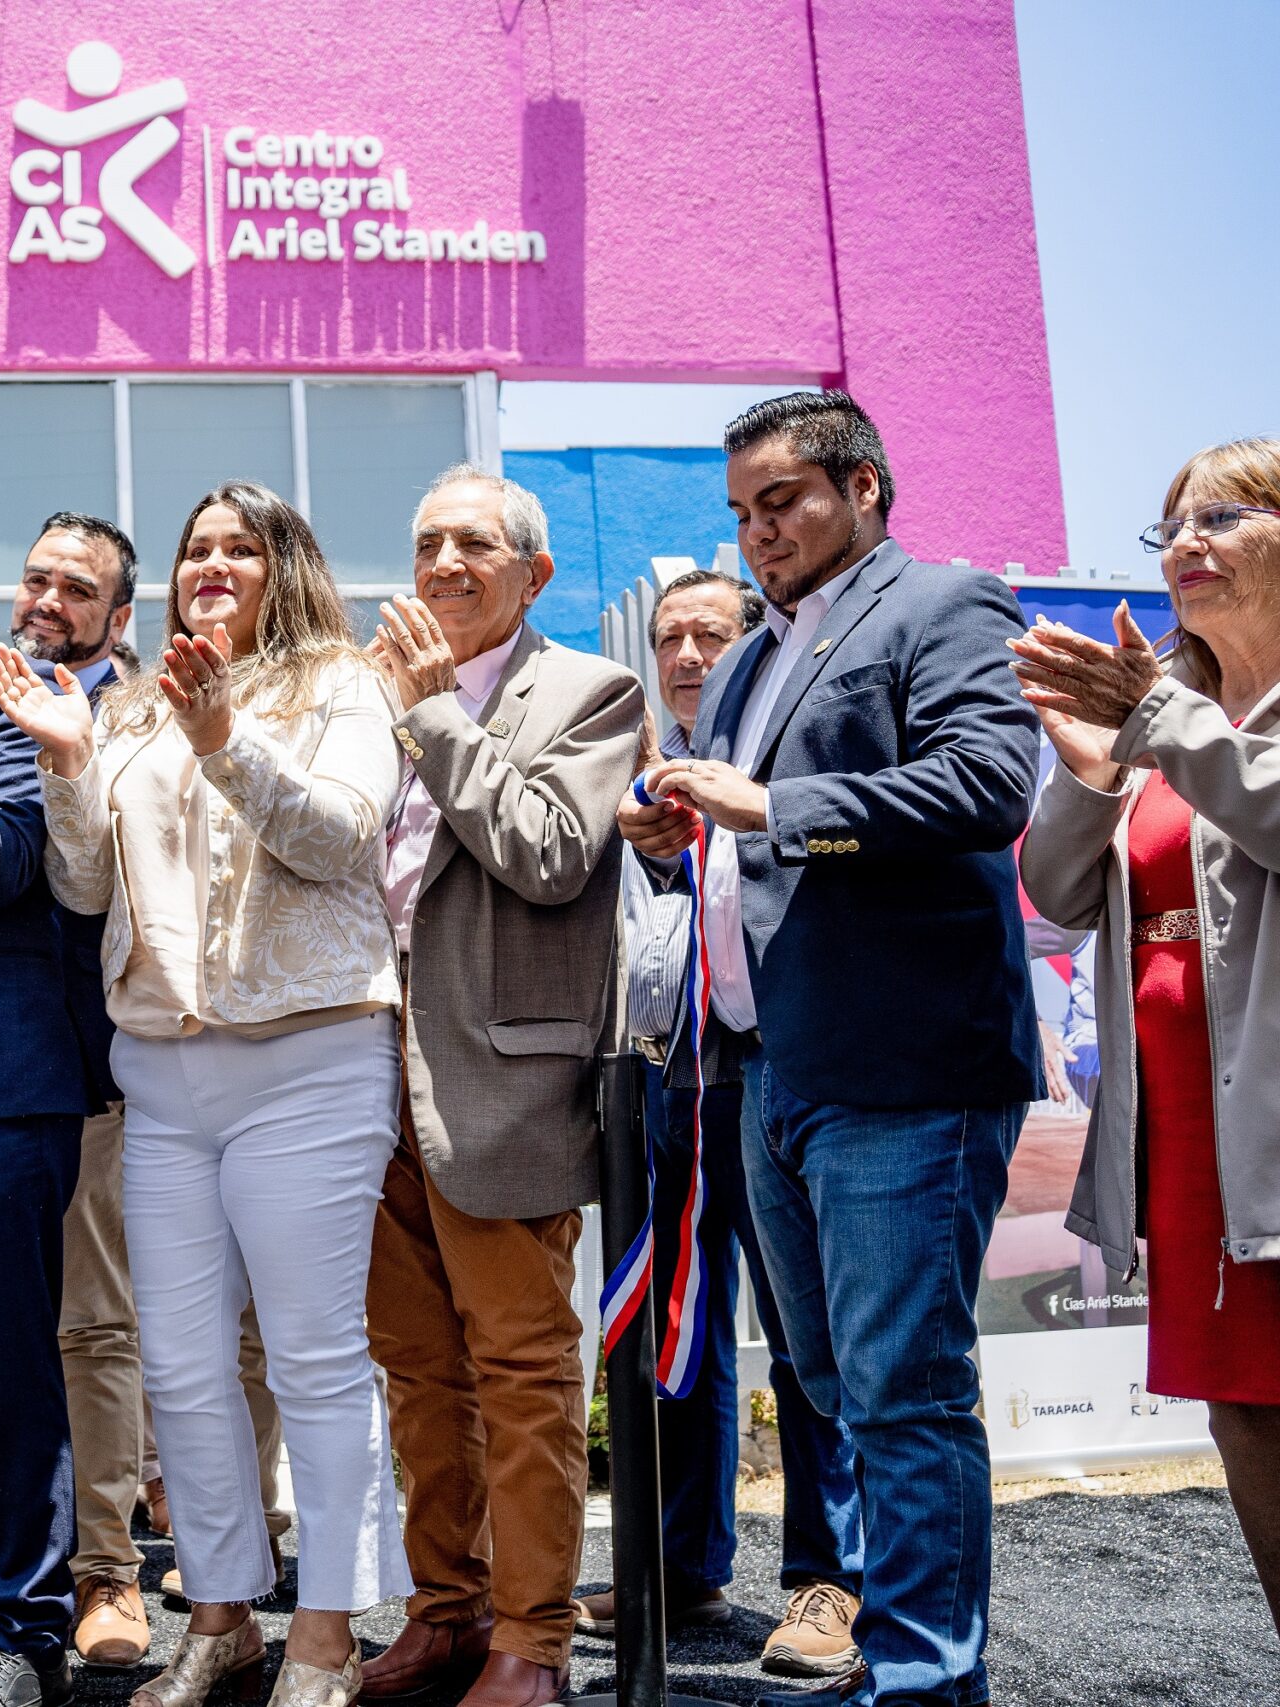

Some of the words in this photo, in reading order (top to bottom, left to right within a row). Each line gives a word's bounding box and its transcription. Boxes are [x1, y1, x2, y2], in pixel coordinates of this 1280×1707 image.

[224, 125, 384, 168] Centro
[10, 149, 82, 205] CI
[227, 167, 412, 218] Integral
[9, 206, 107, 263] AS
[228, 217, 346, 261] Ariel
[353, 219, 548, 263] Standen
[1087, 1295, 1111, 1310] Ariel
[1112, 1293, 1149, 1309] Stande
